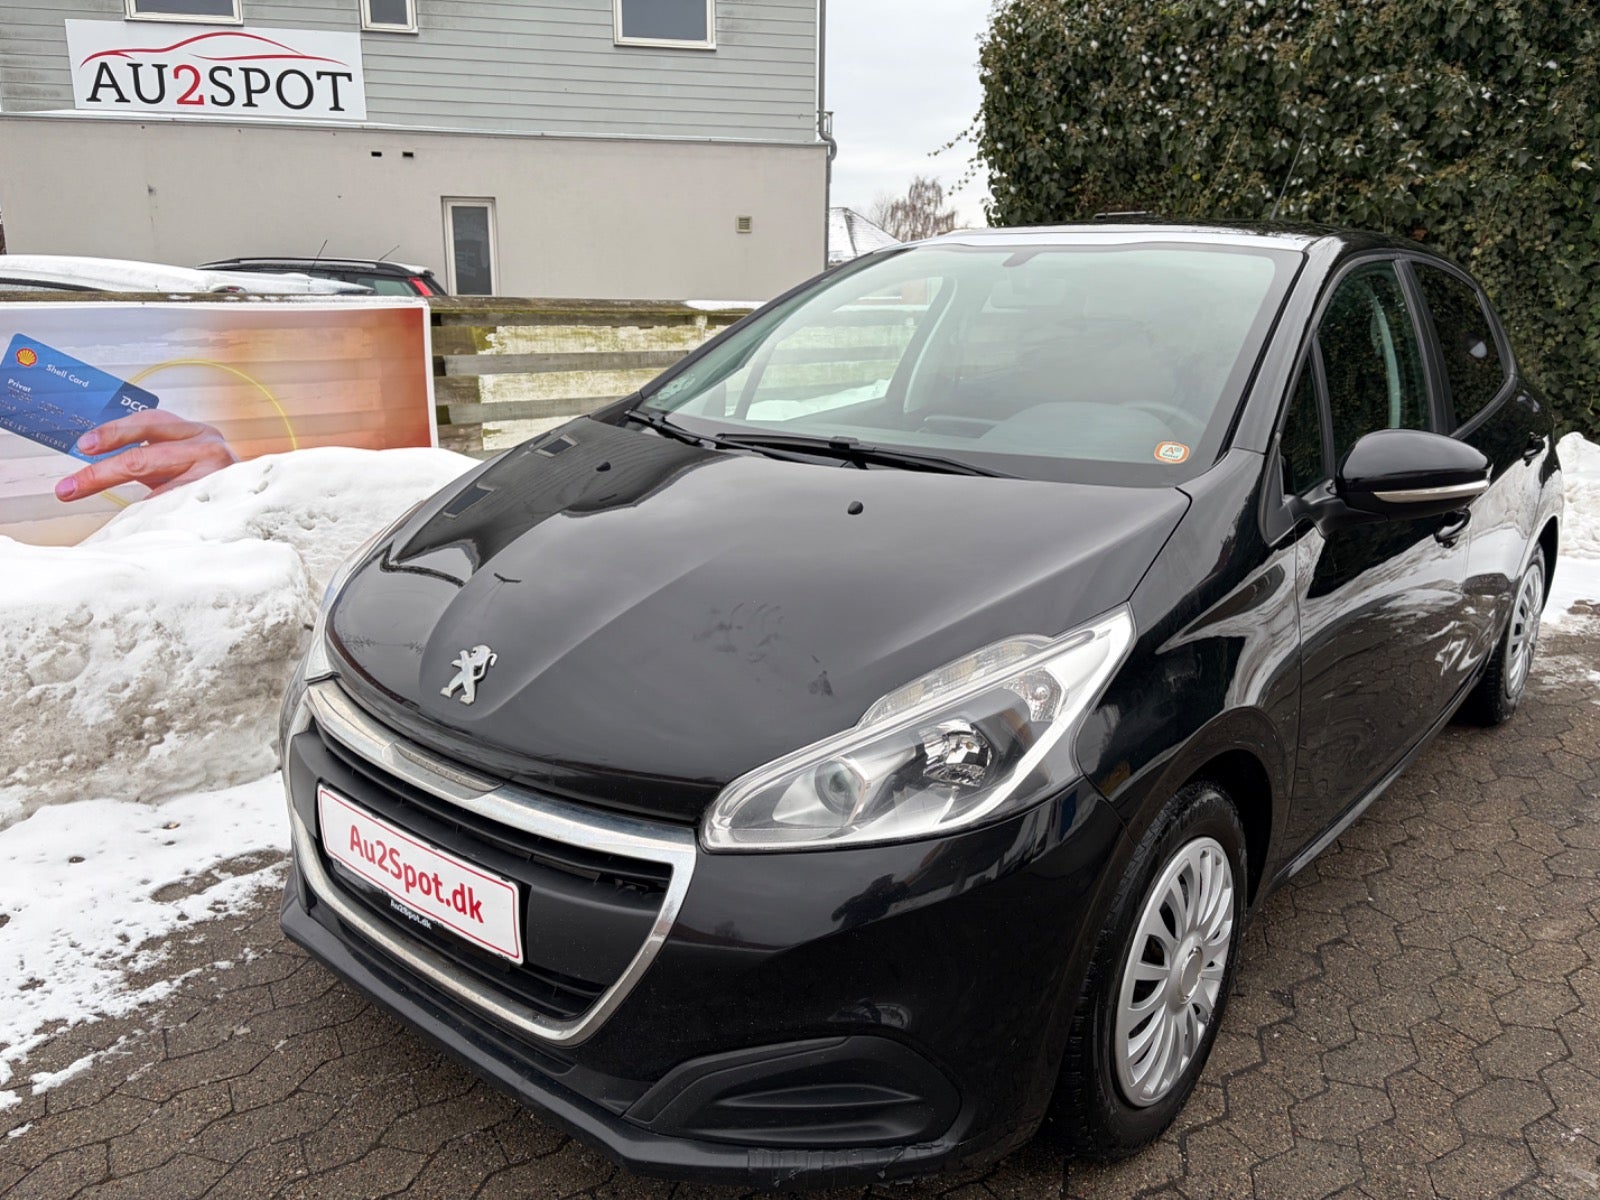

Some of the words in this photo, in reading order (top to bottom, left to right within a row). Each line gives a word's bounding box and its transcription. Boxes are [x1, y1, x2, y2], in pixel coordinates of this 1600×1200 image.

[86, 62, 353, 111] AU2SPOT
[7, 378, 31, 392] Privat
[46, 364, 67, 379] Shell
[68, 375, 90, 388] Card
[349, 824, 484, 924] Au2Spot.dk
[390, 899, 432, 930] Au2Spot.dk
